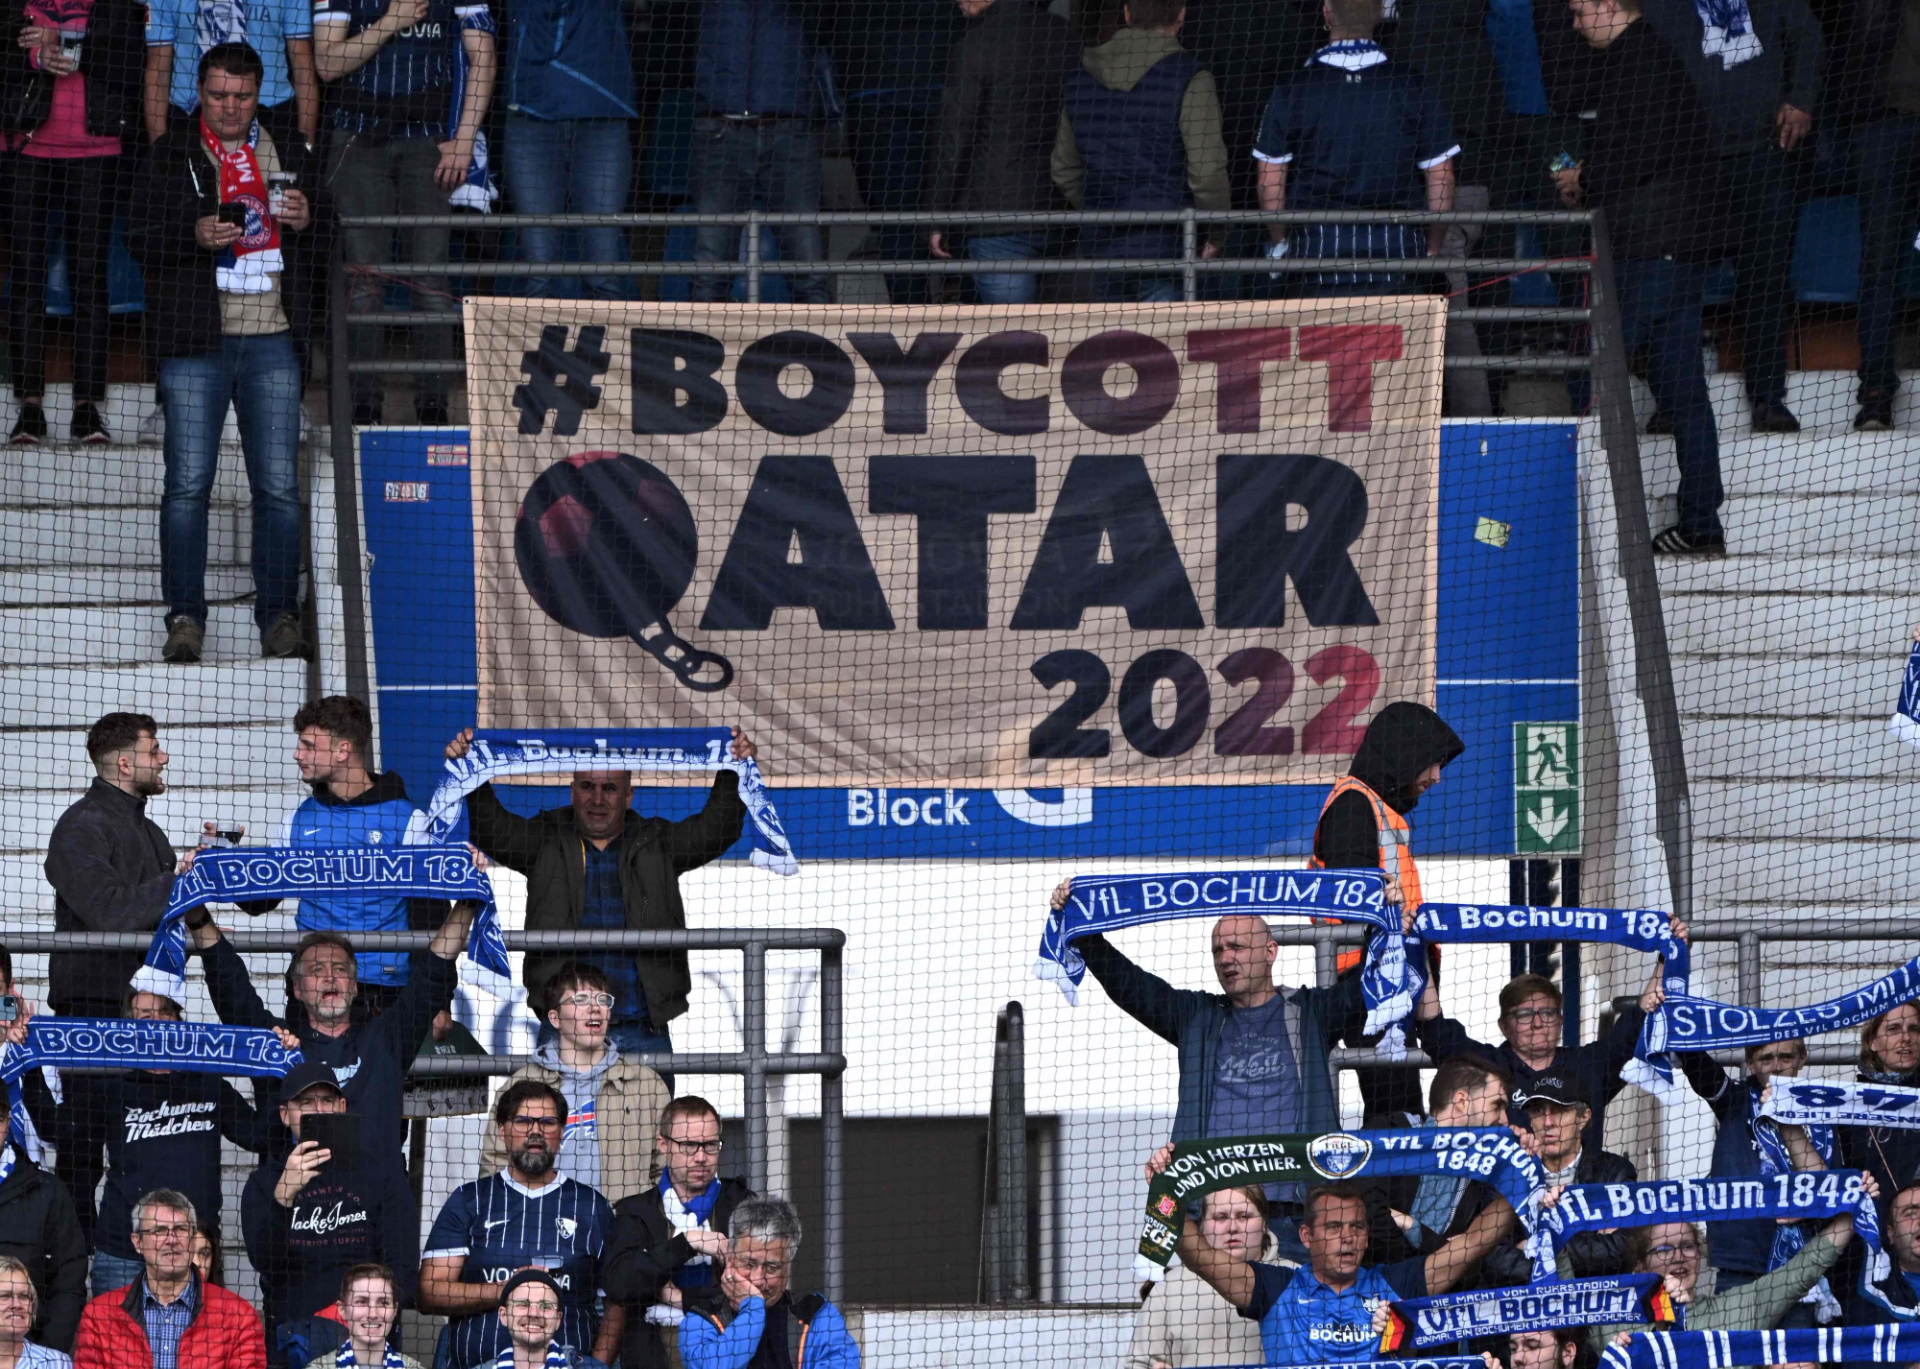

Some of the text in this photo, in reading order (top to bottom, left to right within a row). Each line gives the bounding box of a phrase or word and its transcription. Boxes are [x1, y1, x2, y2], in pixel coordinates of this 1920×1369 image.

[512, 325, 1403, 436] #BOYCOTT
[1028, 645, 1381, 759] 2022
[517, 739, 685, 764] Bochum
[847, 788, 971, 826] Block
[275, 848, 384, 858] MEIN VEREIN
[219, 855, 413, 889] BOCHUM
[1071, 875, 1385, 921] VfL BOCHUM 184
[1414, 908, 1449, 932] fL
[1458, 906, 1607, 931] Bochum
[95, 1020, 206, 1032] MEIN VEREIN
[1774, 1029, 1799, 1039] DES
[1833, 1001, 1889, 1028] BOCHUM
[36, 1027, 236, 1058] BOCHUM
[125, 1101, 216, 1124] Bochumer
[1164, 1143, 1285, 1179] VON HERZEN
[1431, 1131, 1539, 1189] BOCHUM
[1436, 1150, 1497, 1176] 1848
[1174, 1156, 1301, 1198] UND VON HIER.
[1540, 1173, 1863, 1235] VfL Bochum 1848
[1142, 1223, 1178, 1251] EGE
[1424, 1288, 1630, 1333] VfL BOCHUM
[1431, 1297, 1449, 1308] DIE
[1456, 1290, 1496, 1303] MACHT
[1309, 1328, 1378, 1343] BOCHUM
[1336, 1322, 1375, 1332] JAHR
[1456, 1327, 1473, 1339] EIN
[1532, 1317, 1566, 1328] IMMER
[1569, 1314, 1585, 1325] EIN
